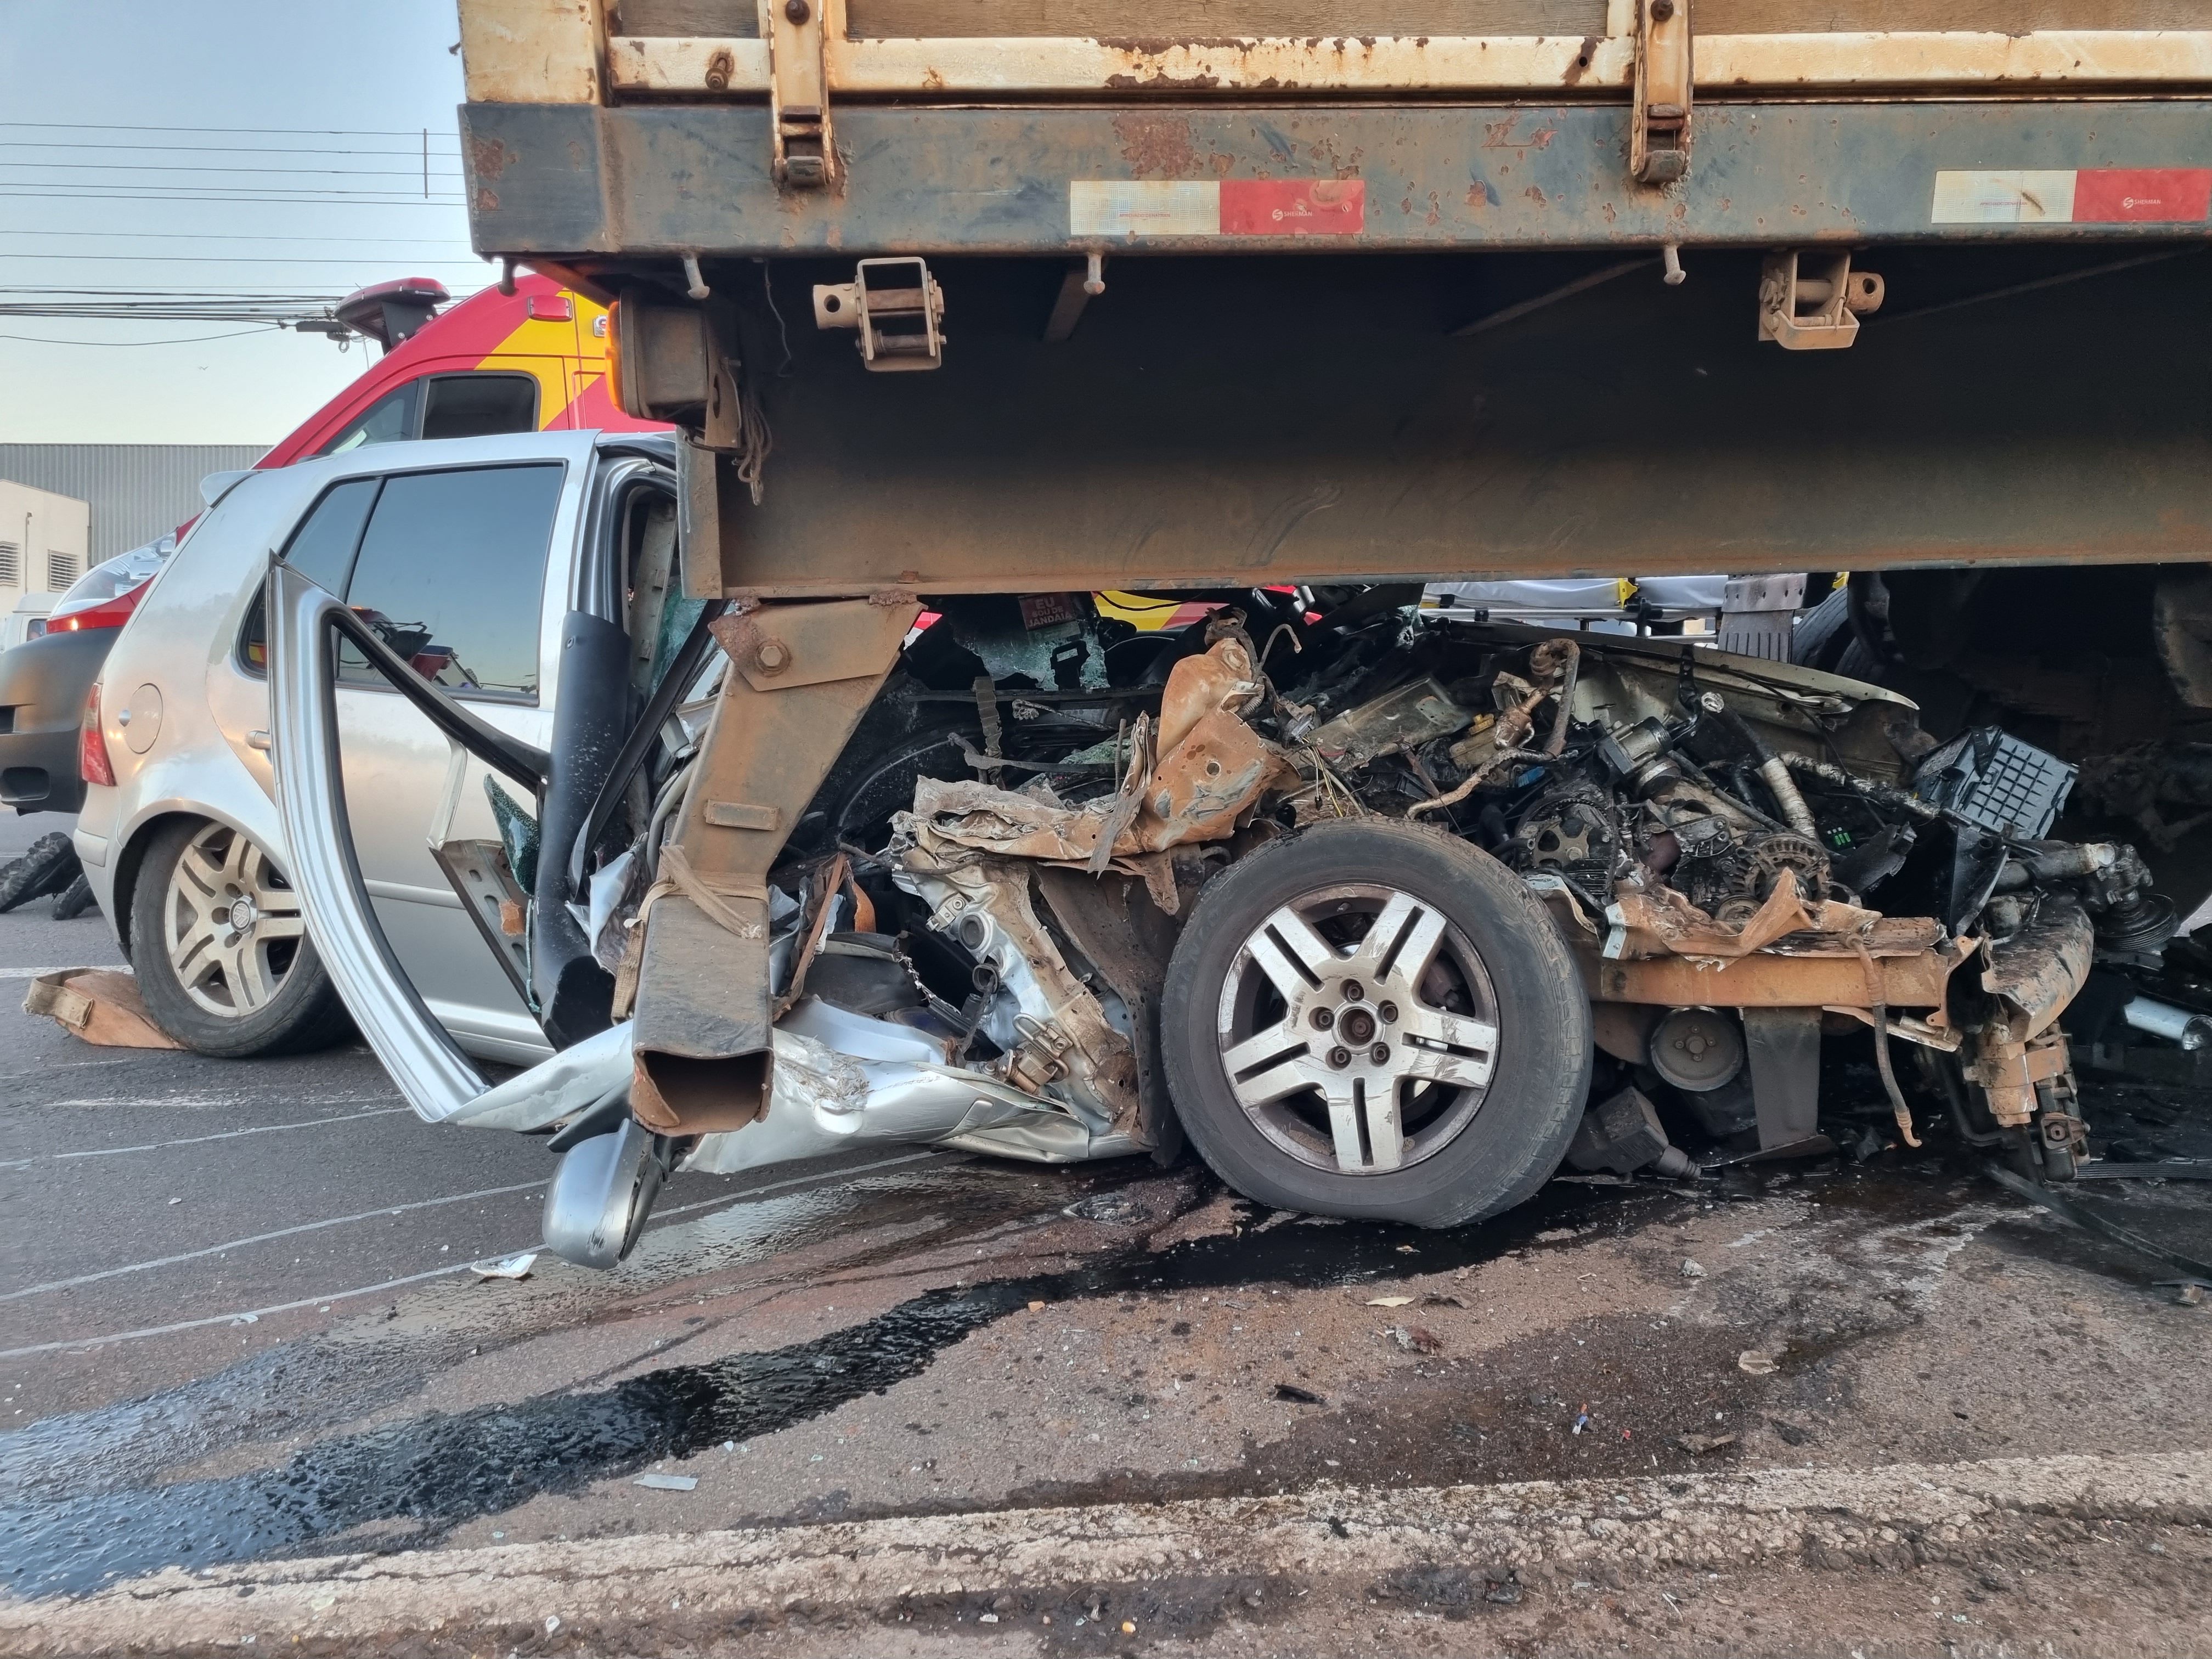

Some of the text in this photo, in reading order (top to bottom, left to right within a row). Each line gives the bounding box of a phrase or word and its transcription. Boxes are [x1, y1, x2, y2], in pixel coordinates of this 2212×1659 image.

[1035, 597, 1055, 610] EU
[1032, 606, 1064, 618] SOU DE
[1028, 612, 1073, 627] JANDAIA
